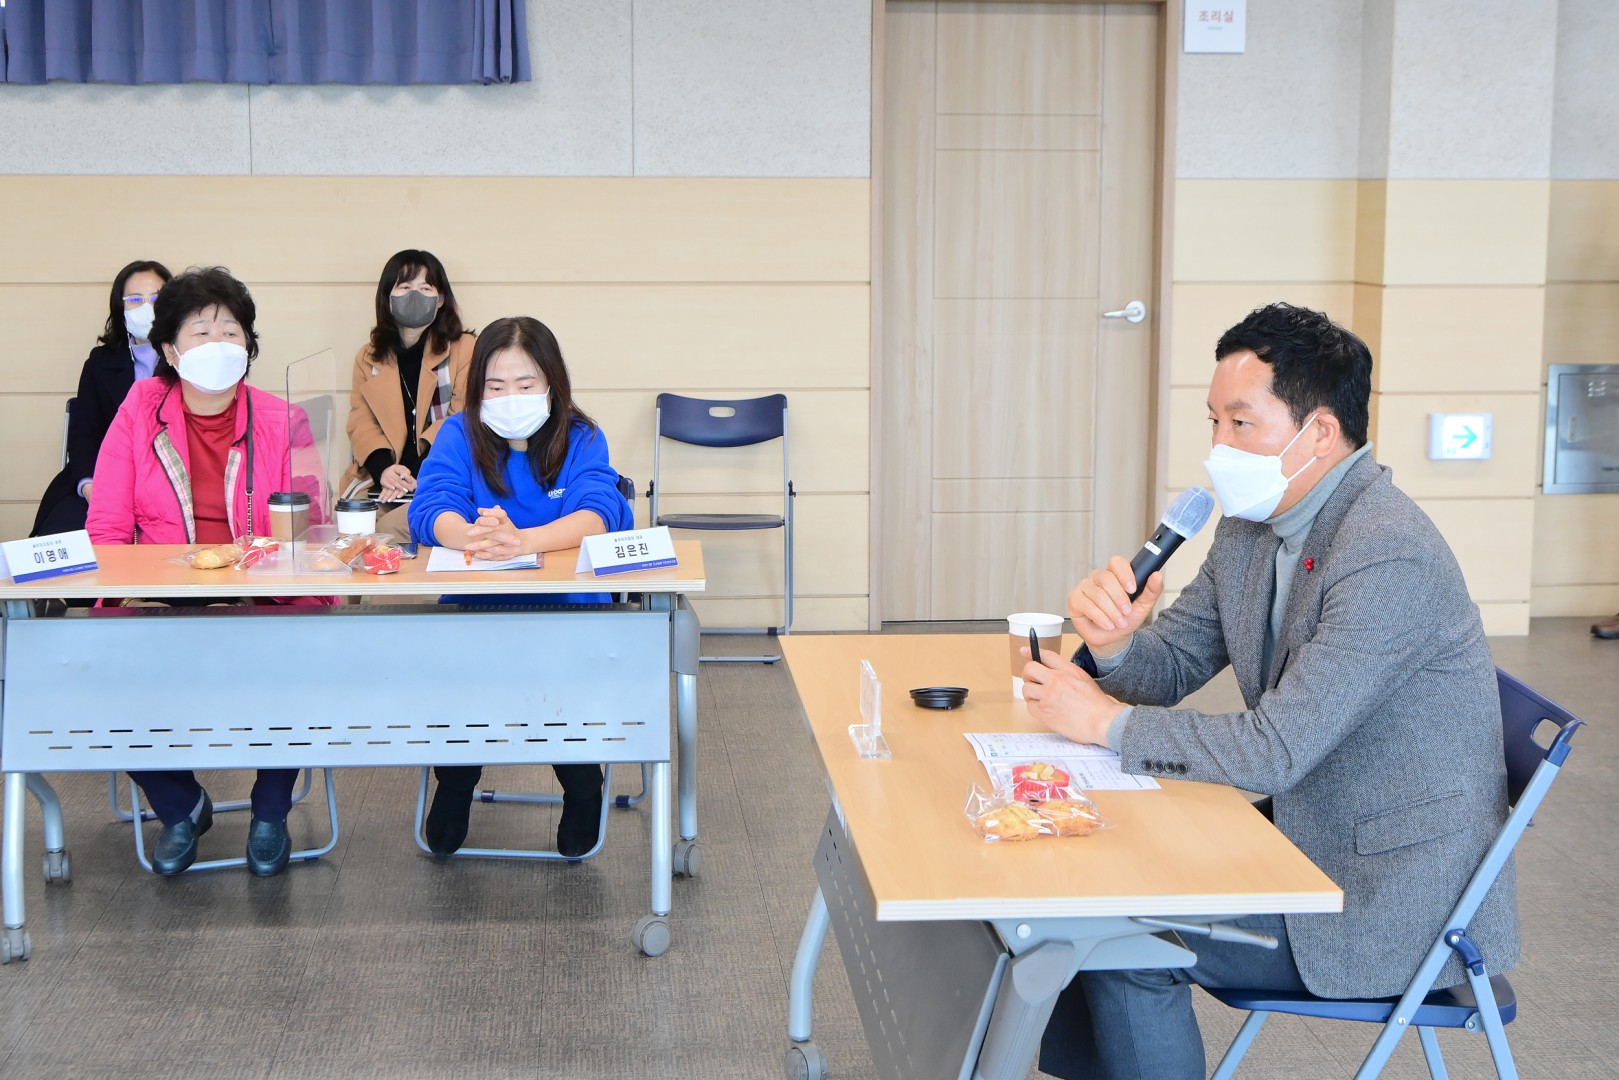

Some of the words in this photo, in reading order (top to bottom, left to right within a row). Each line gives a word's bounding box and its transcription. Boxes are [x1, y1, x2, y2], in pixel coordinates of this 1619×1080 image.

[1199, 10, 1234, 23] 조리실
[33, 547, 69, 564] 이영애
[614, 543, 650, 558] 김은진
